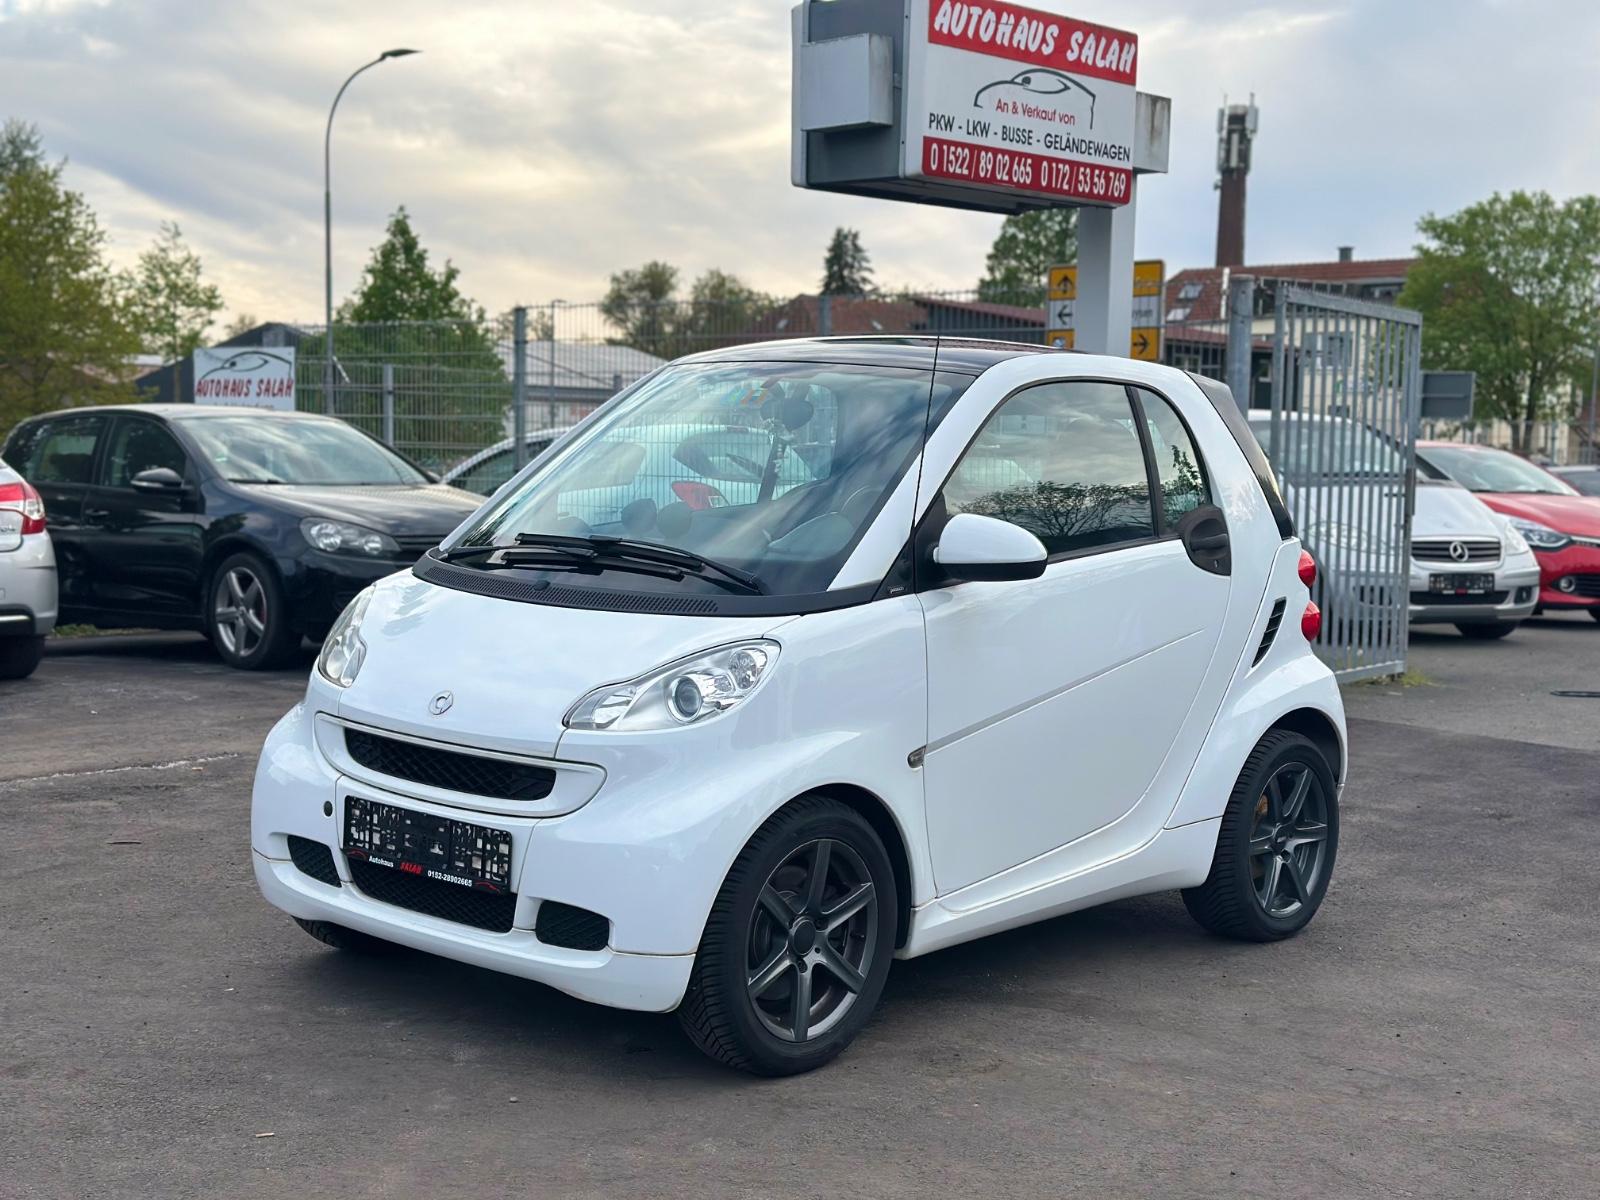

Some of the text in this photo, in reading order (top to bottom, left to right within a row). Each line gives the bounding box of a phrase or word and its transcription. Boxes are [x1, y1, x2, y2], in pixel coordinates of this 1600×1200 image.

[934, 0, 1136, 74] AUTOHAUS SALAH
[995, 98, 1076, 126] An & Verkauf von
[928, 112, 955, 132] PKW
[966, 119, 991, 138] LKW
[1001, 125, 1033, 146] BUSSE
[1044, 133, 1131, 162] GELÄNDEWAGEN
[942, 145, 970, 175] 1522
[1012, 156, 1032, 185] 665
[1108, 172, 1126, 198] 769
[195, 378, 294, 397] AUTOHAUS SALAH
[368, 855, 394, 868] Autohaus
